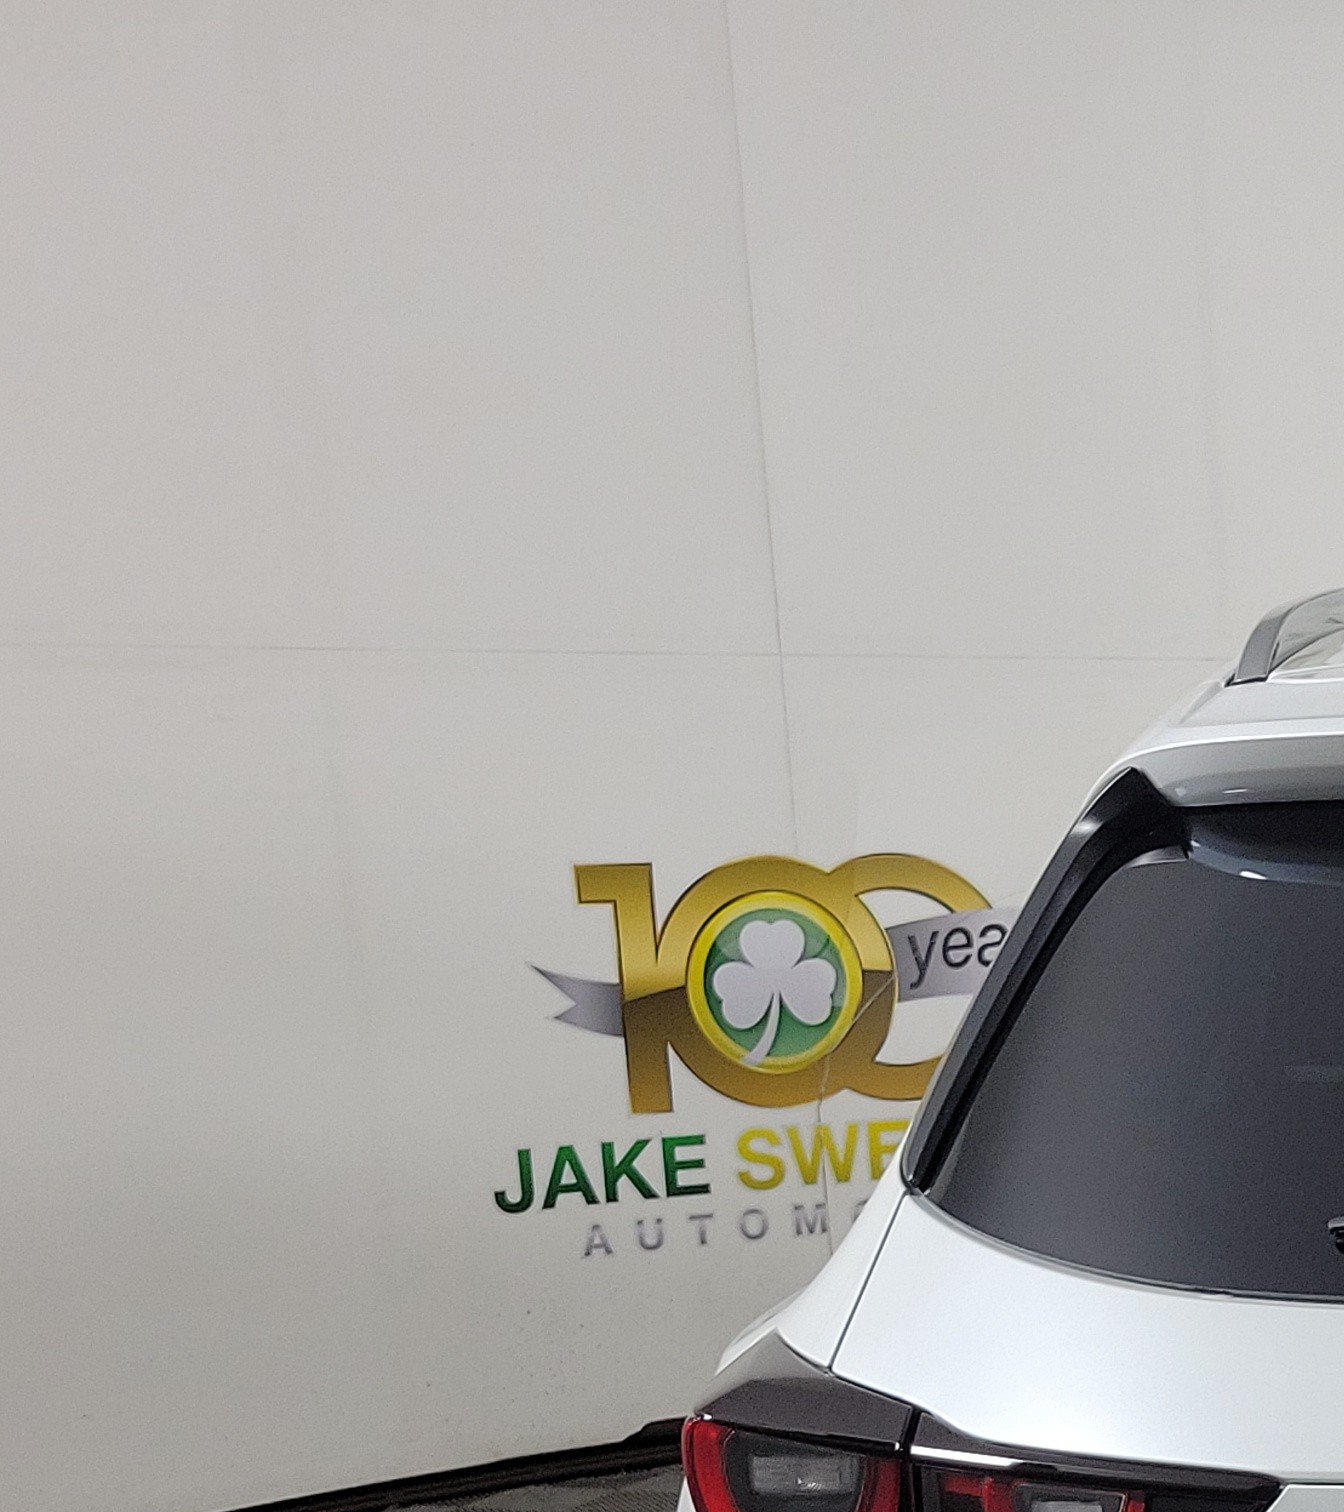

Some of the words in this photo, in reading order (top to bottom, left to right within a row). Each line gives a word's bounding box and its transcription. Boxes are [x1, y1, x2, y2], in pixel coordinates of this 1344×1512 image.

[574, 853, 993, 1114] 100
[494, 1134, 712, 1214] JAKE
[583, 1199, 868, 1258] AUTOM
